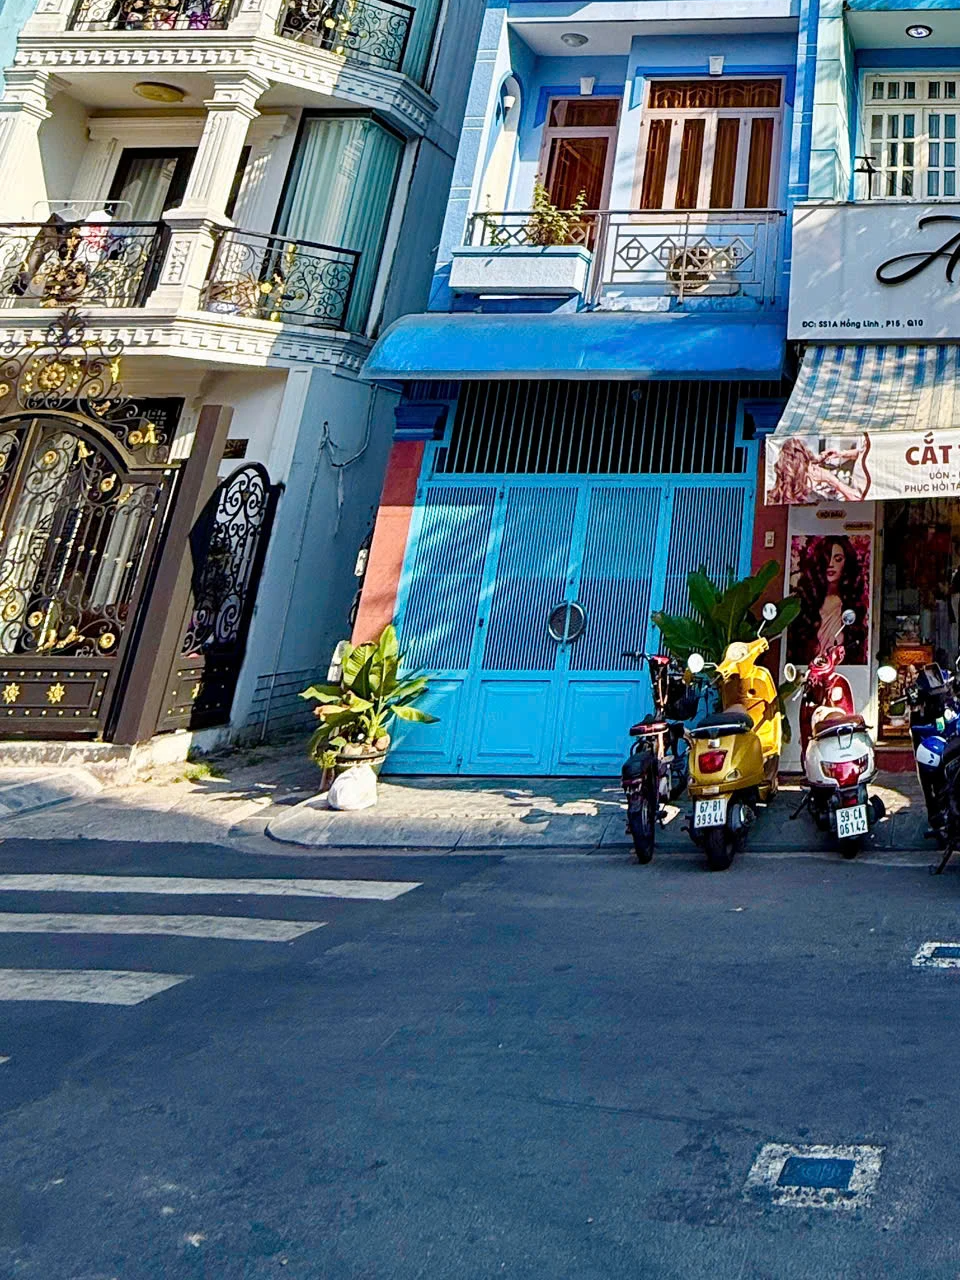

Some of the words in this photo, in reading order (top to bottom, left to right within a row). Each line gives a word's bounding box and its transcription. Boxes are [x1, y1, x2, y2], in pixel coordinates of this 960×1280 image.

[907, 319, 923, 328] Q10
[905, 431, 952, 465] CẮT
[904, 484, 930, 494] PHỤC
